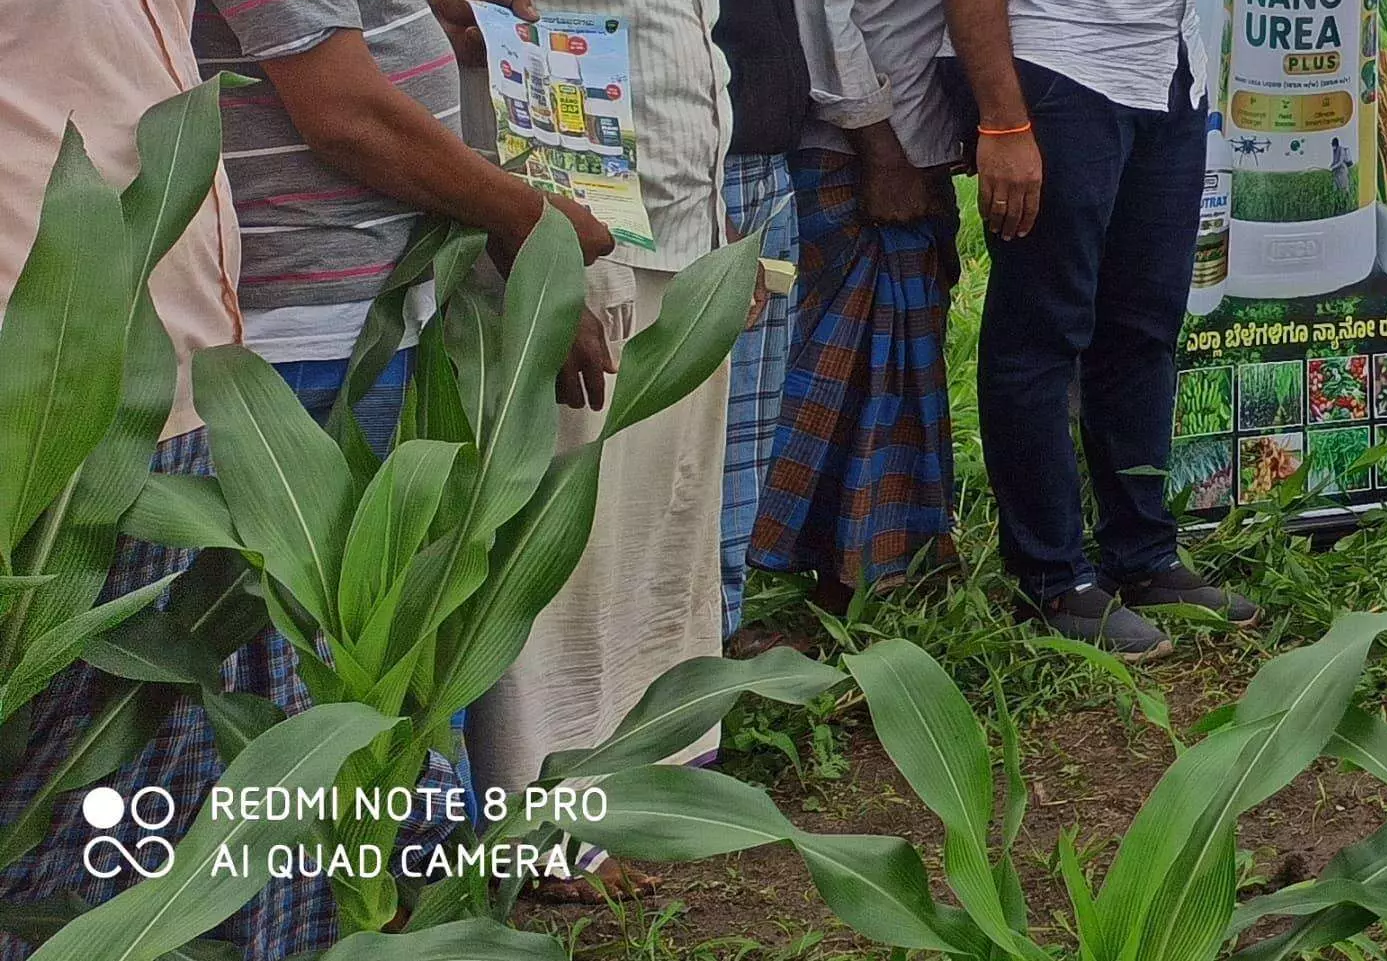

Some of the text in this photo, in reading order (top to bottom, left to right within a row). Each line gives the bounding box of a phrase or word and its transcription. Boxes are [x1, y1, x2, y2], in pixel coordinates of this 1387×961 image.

[1245, 12, 1341, 50] UREA
[1288, 55, 1336, 72] PLUS
[1186, 330, 1222, 357] ಎಲ್ಲಾ
[1225, 320, 1309, 348] ಬೆಳೆಗಳಿಗೂ
[1313, 316, 1375, 350] ನ್ಯಾನೋ
